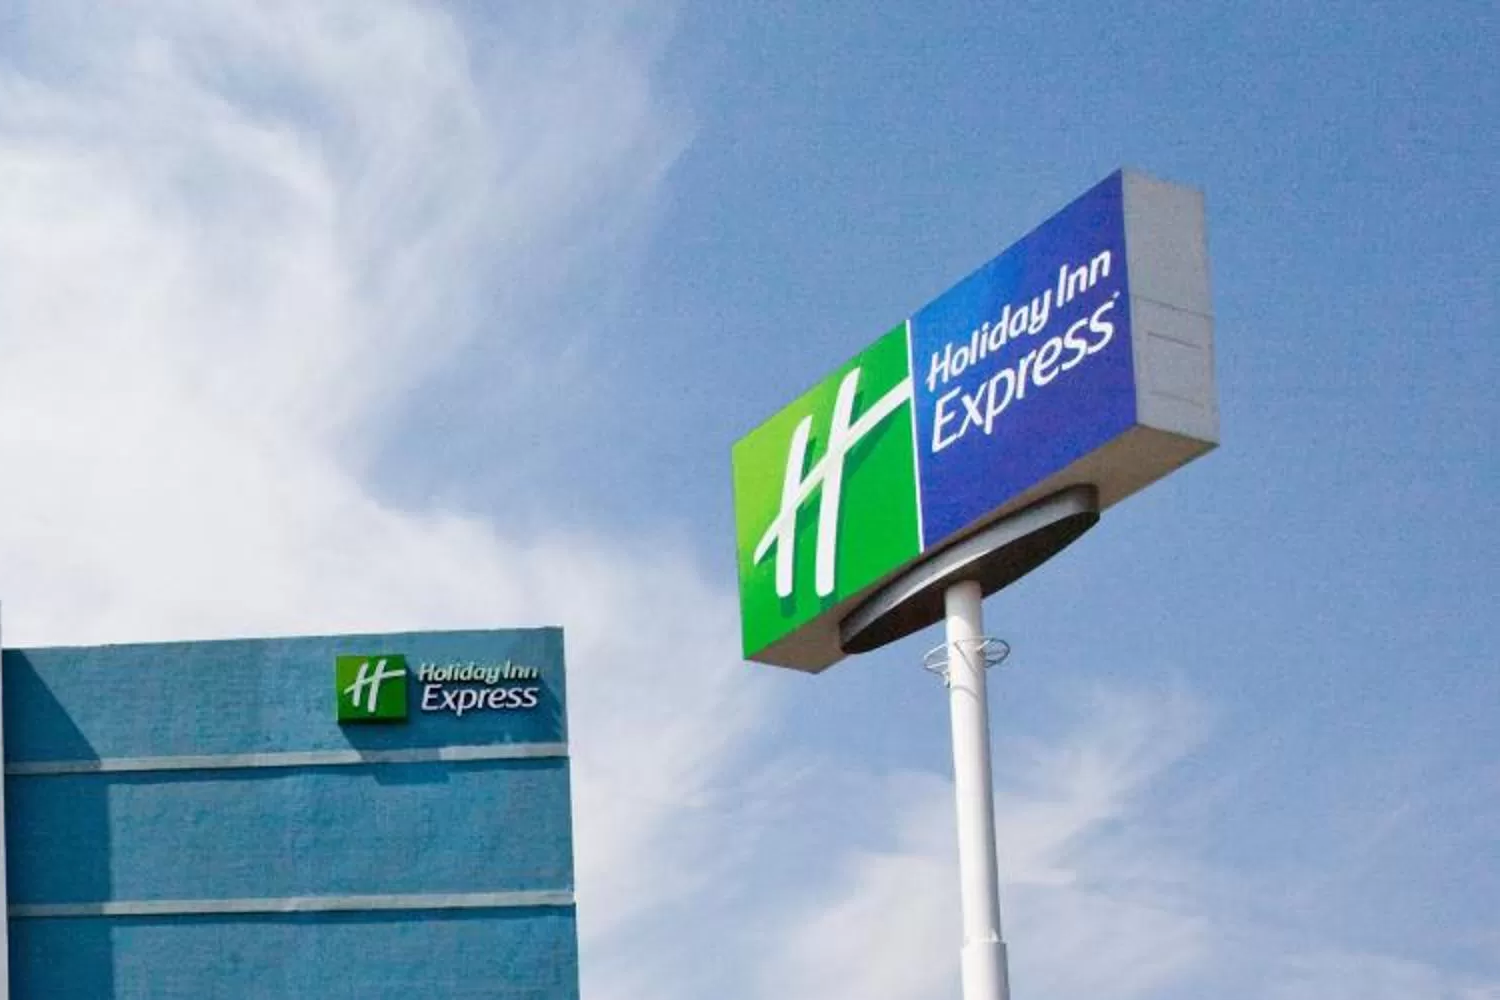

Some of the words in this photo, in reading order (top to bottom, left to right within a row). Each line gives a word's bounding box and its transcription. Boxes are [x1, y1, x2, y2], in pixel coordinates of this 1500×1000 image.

[925, 289, 1052, 393] Holiday
[1056, 250, 1111, 308] Inn
[932, 301, 1115, 453] Express
[418, 662, 502, 684] Holiday
[503, 660, 538, 679] Inn
[421, 684, 539, 716] Express
